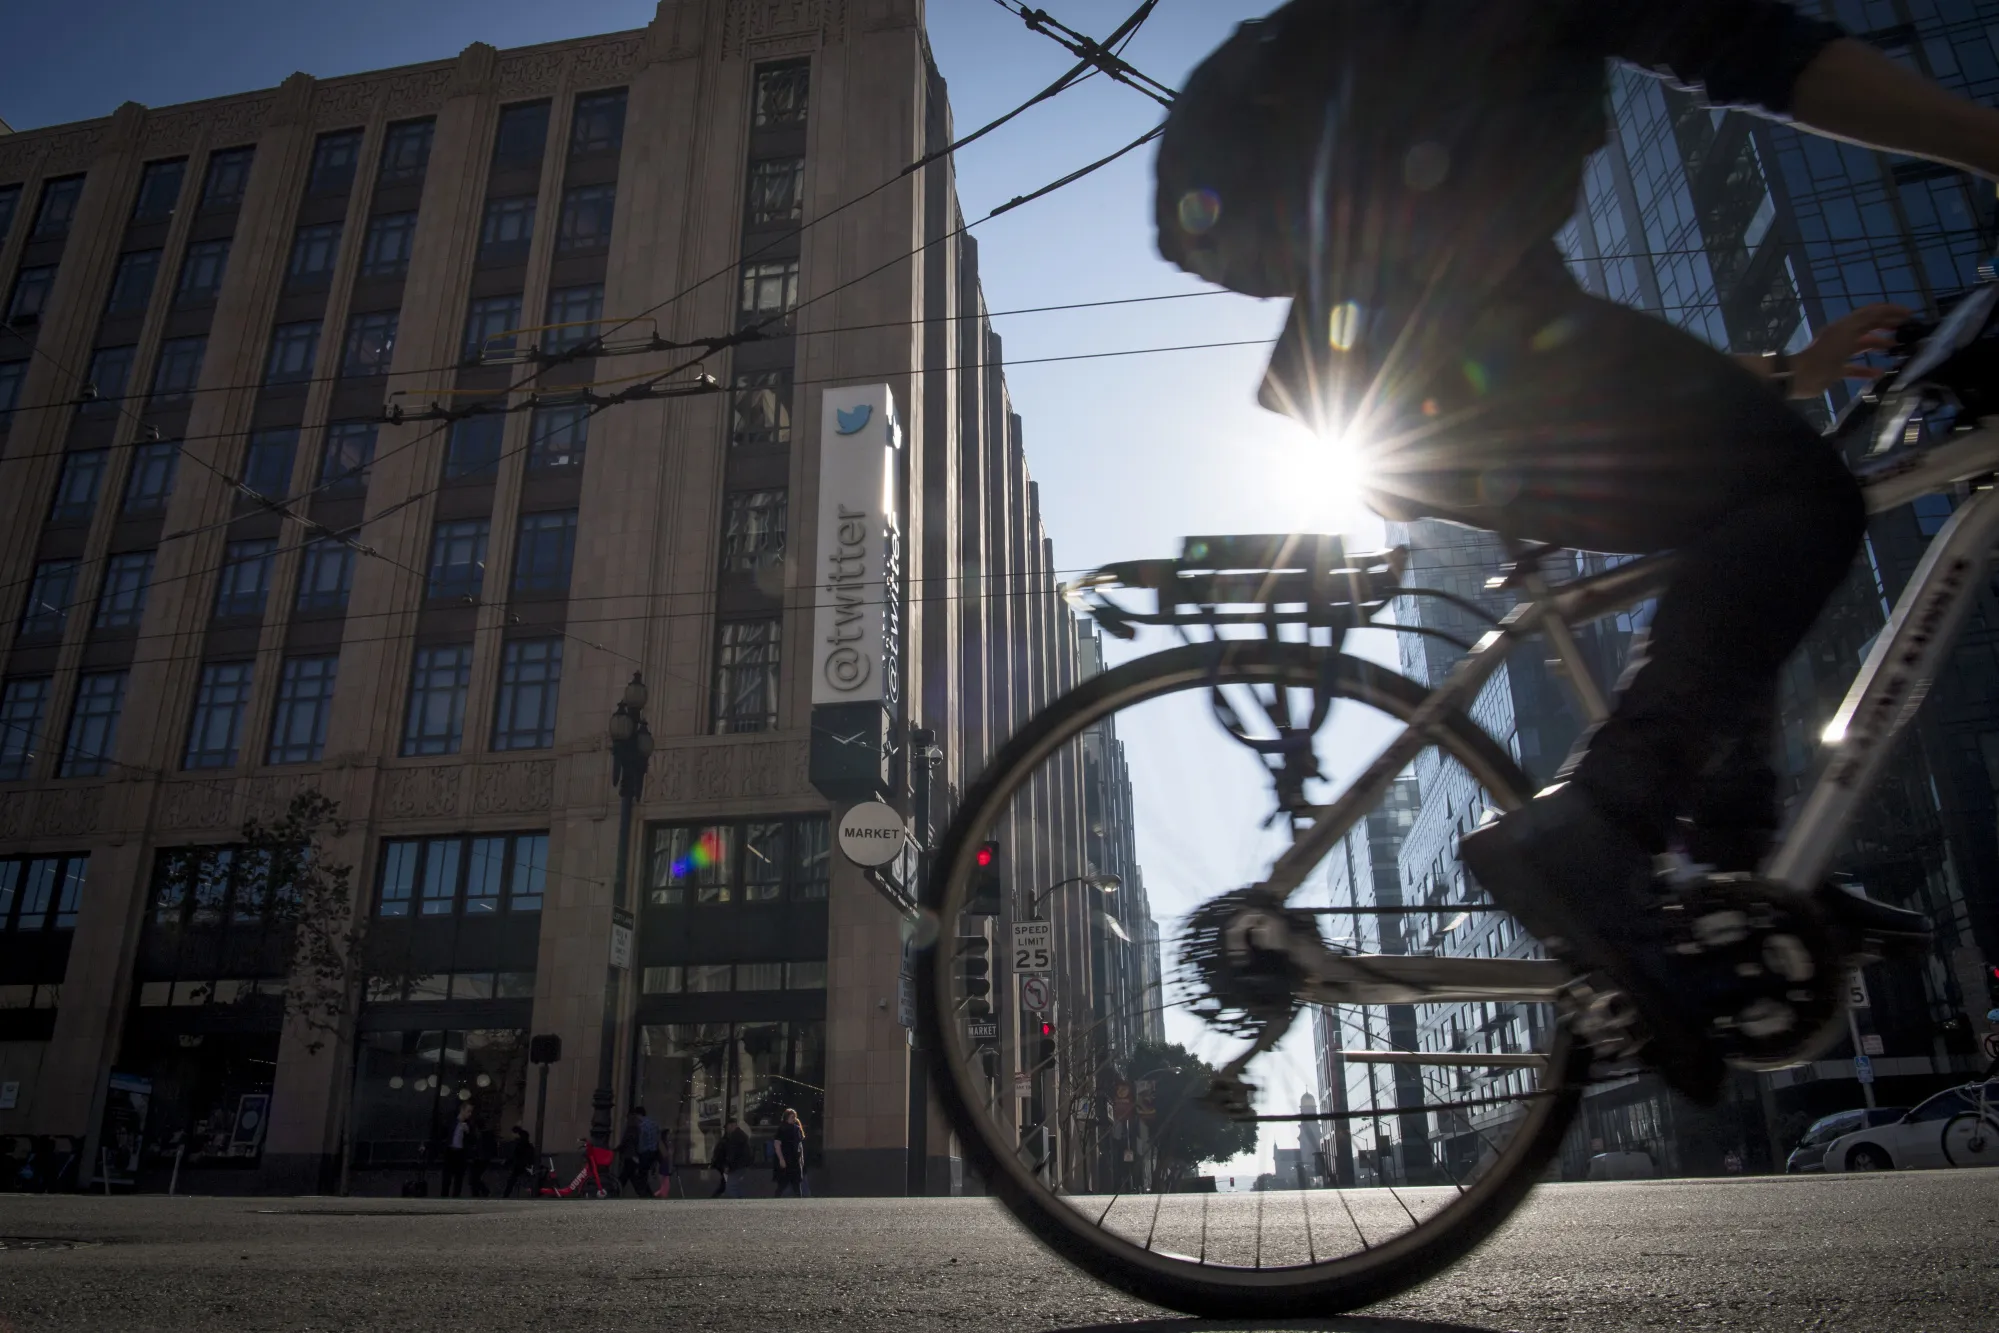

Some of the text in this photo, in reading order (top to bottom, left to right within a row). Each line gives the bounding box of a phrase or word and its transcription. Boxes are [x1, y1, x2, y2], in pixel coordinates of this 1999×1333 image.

[824, 503, 871, 692] @twitter
[886, 511, 900, 703] @twitter
[844, 828, 900, 839] MARKET
[1014, 926, 1049, 935] SPEED
[1018, 937, 1045, 946] LIMIT
[1016, 949, 1049, 968] 25
[968, 1026, 997, 1036] MARKET
